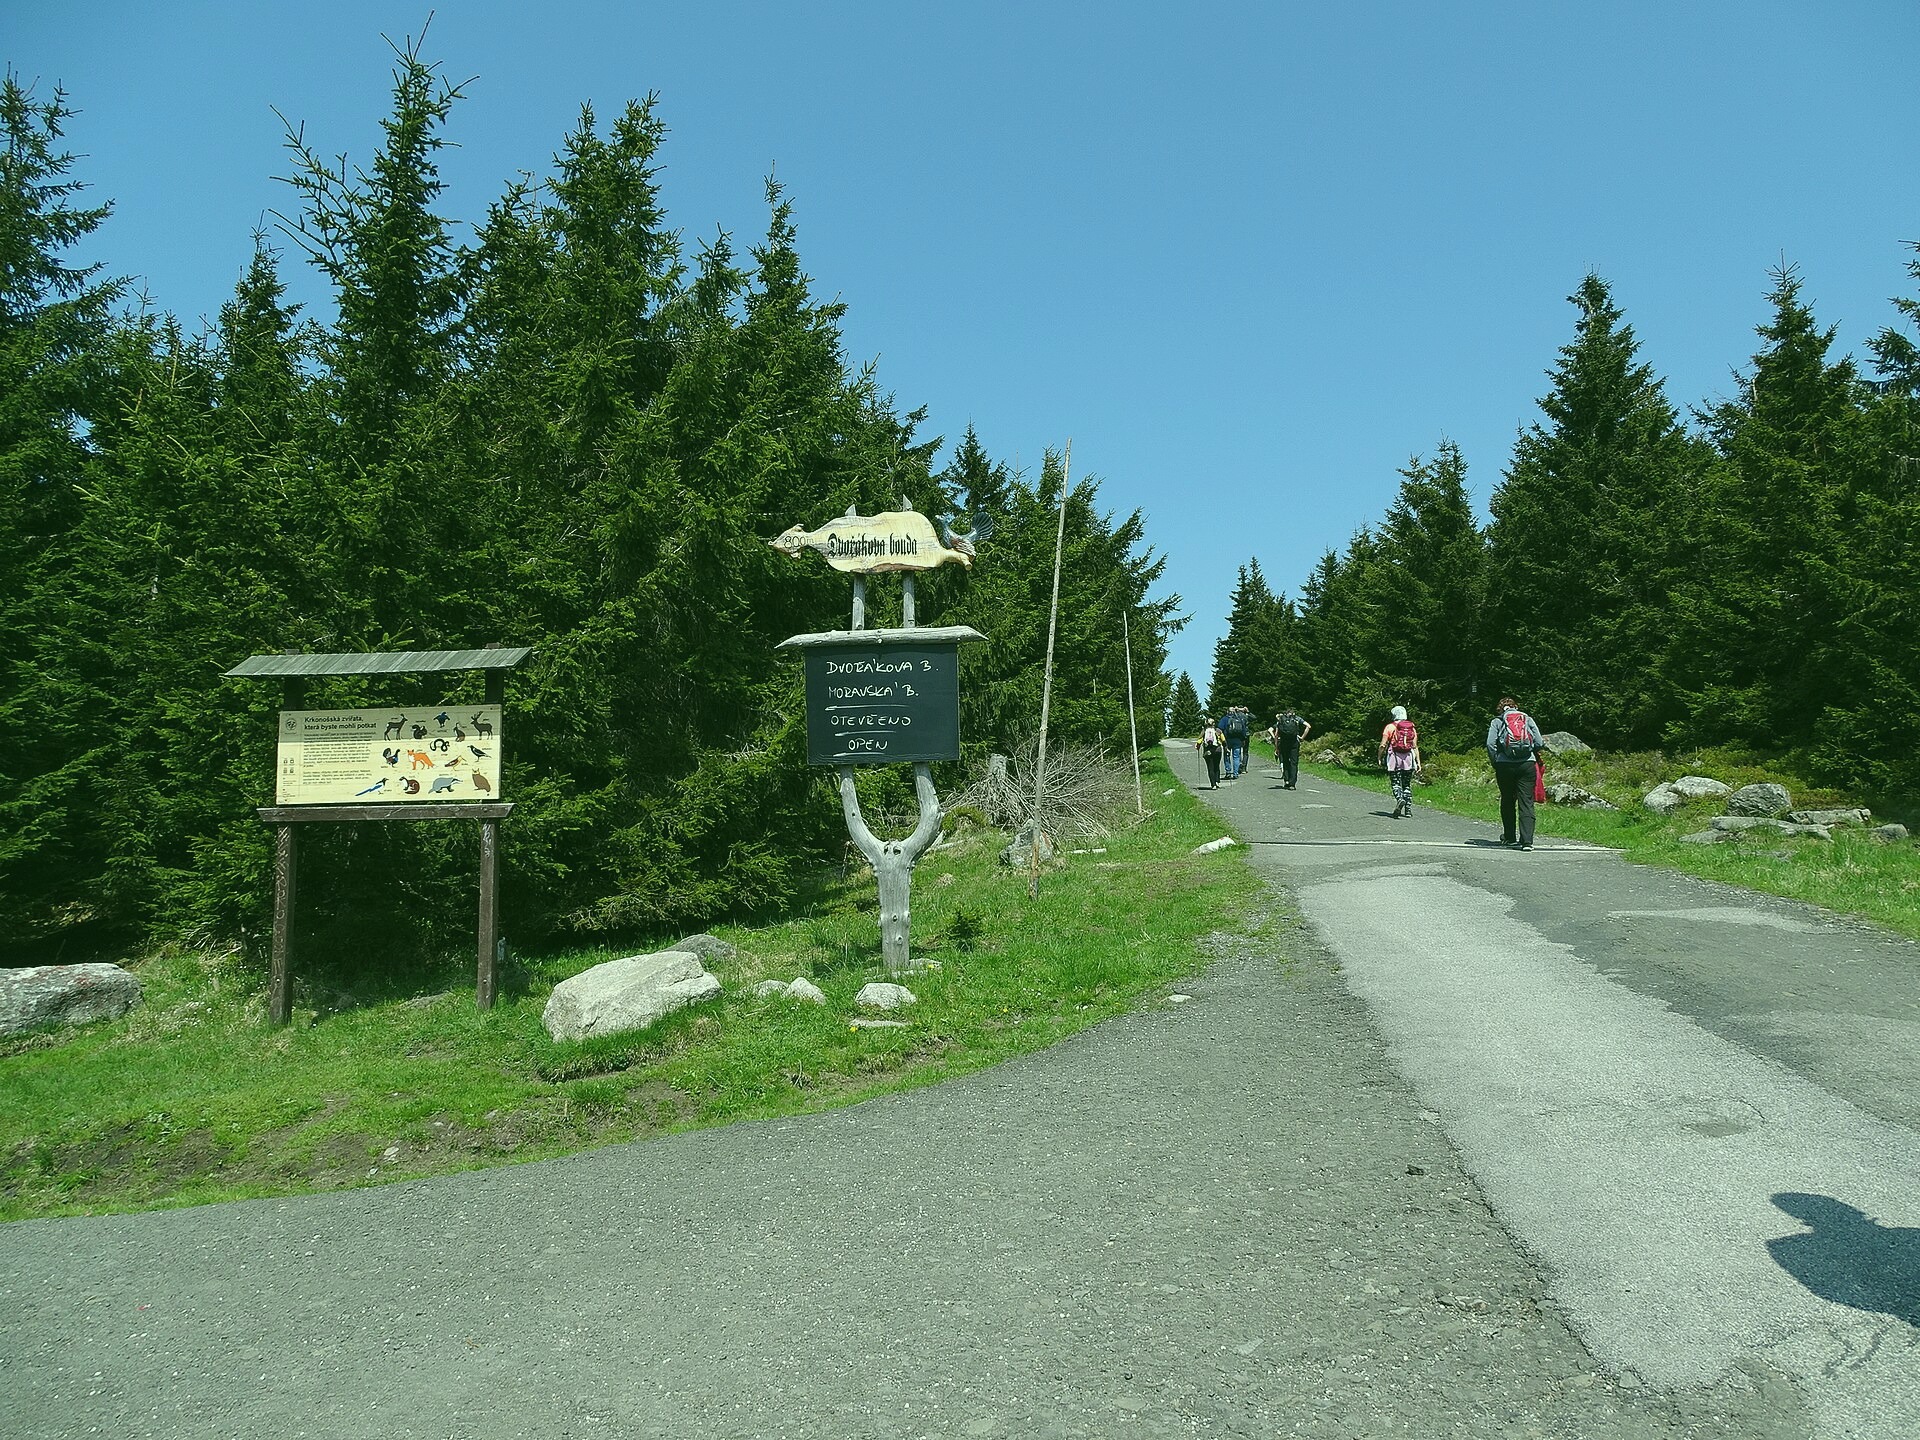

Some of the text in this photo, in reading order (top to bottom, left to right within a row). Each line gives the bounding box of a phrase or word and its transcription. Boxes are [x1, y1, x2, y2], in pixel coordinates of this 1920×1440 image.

[889, 533, 917, 556] bouda
[920, 660, 939, 672] B.
[902, 684, 920, 697] B.
[848, 738, 888, 751] OPEN
